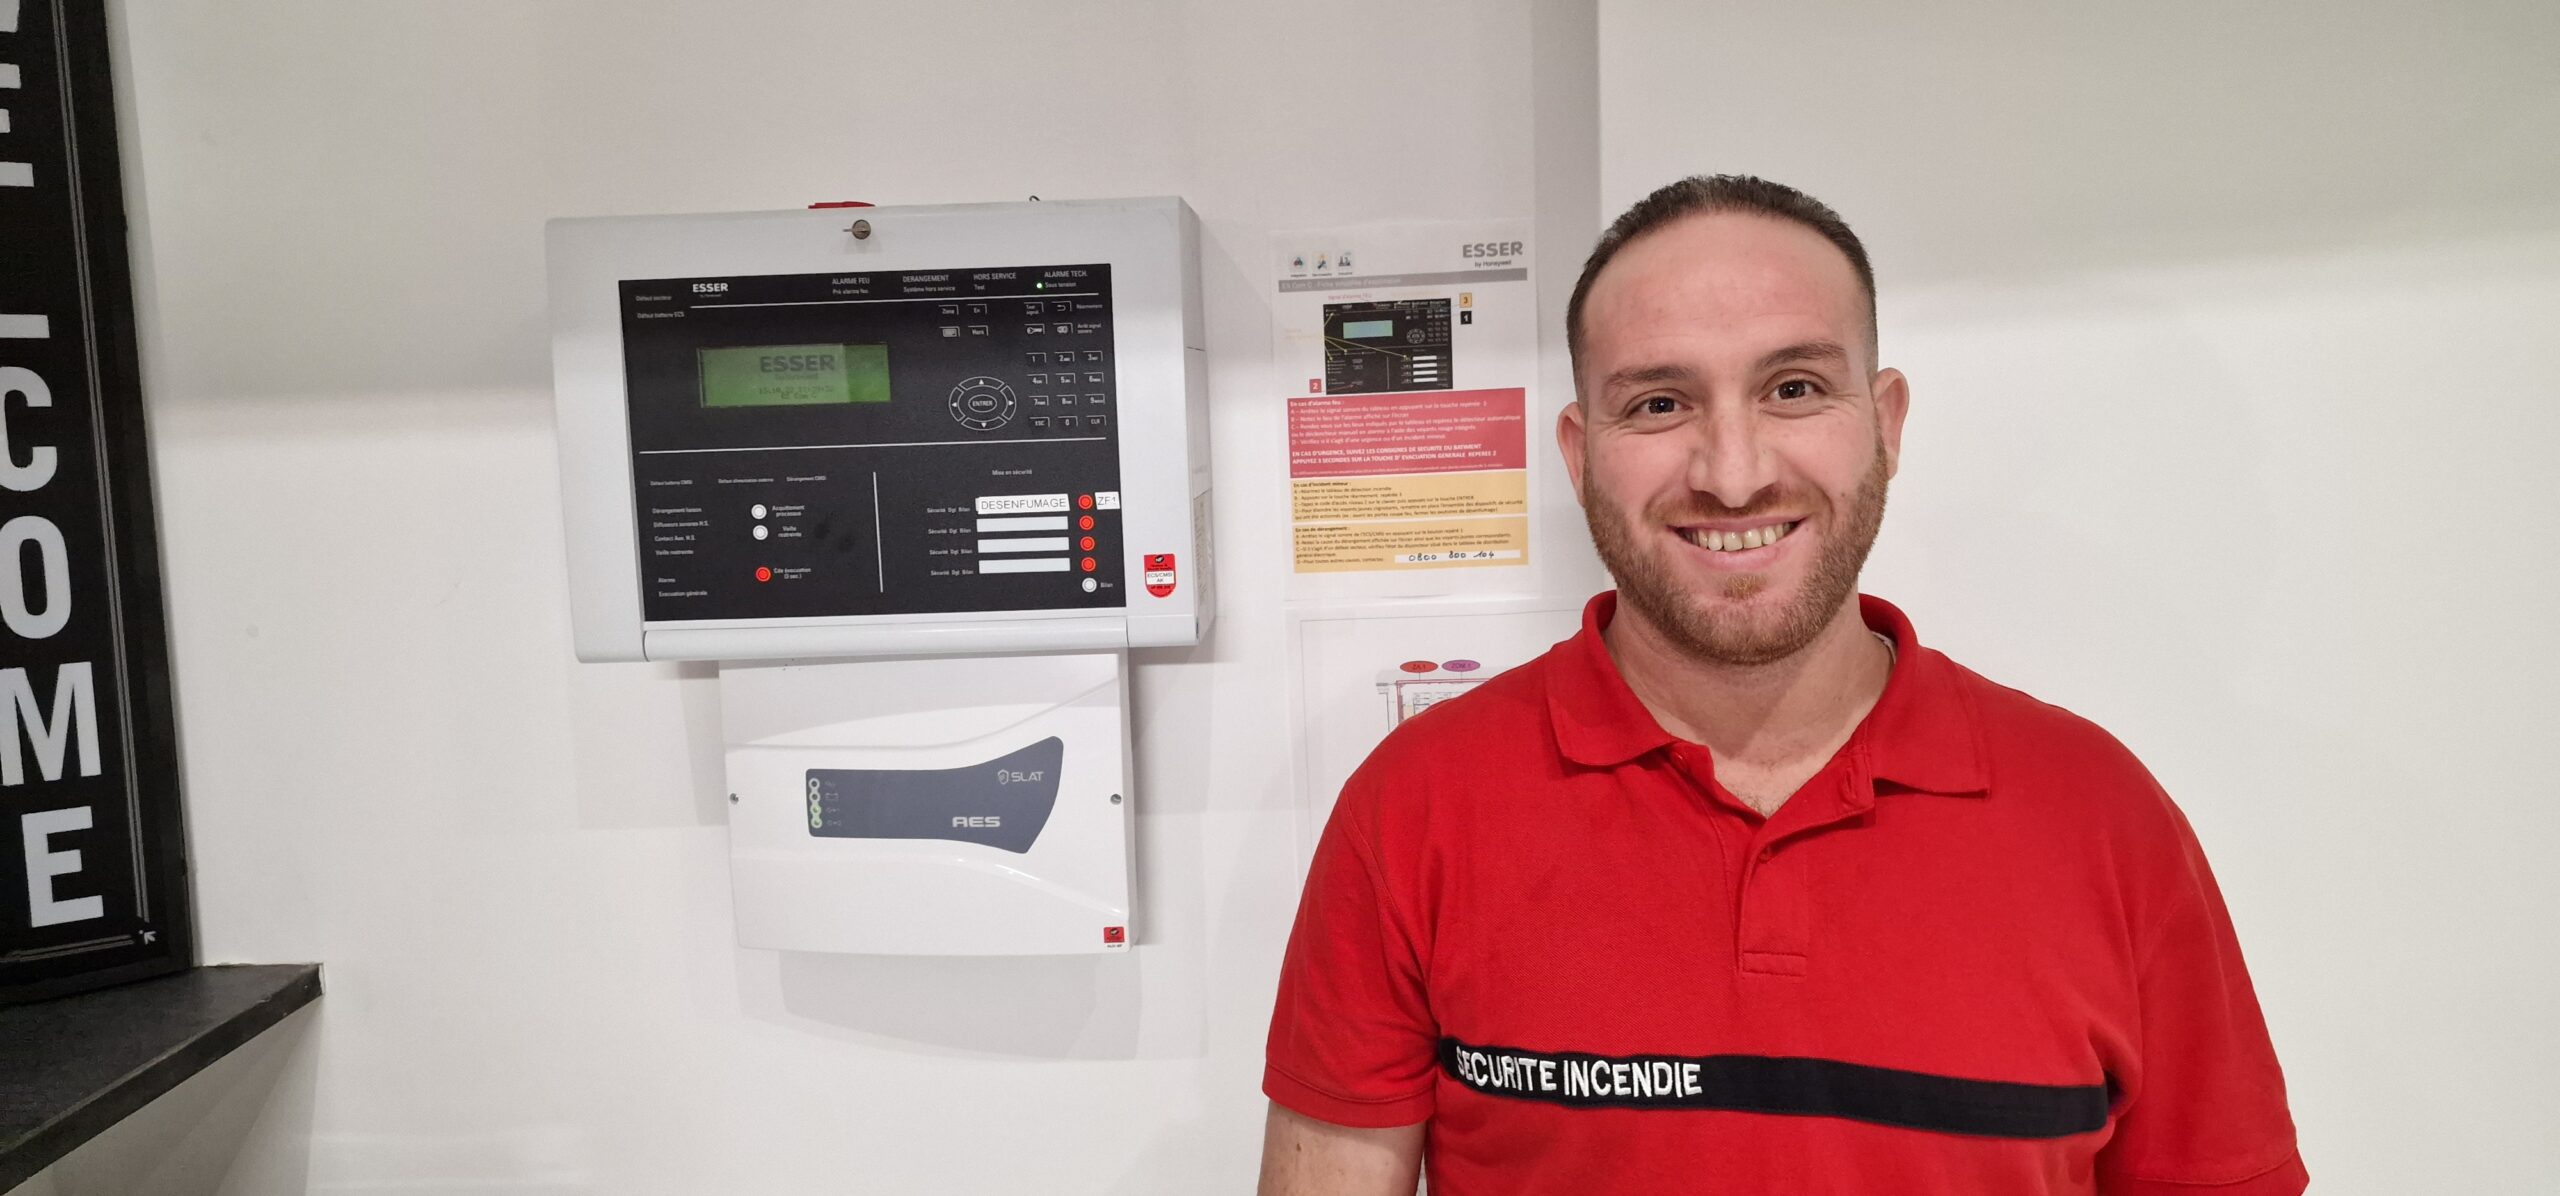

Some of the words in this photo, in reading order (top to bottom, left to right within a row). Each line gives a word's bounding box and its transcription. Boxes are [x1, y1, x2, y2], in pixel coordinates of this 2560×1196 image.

[1462, 241, 1523, 258] ESSER
[902, 274, 949, 282] DERANGEMENT
[992, 272, 1016, 280] SERVICE
[692, 283, 728, 292] ESSER
[1463, 296, 1469, 305] 3
[1464, 314, 1469, 322] 1
[760, 354, 835, 373] ESSER
[1312, 382, 1318, 390] 2
[0, 0, 103, 928] COME
[981, 498, 1067, 510] DESENFUMAGE
[1409, 553, 1437, 562] 0800
[1011, 771, 1044, 782] SLAT
[952, 816, 1001, 828] AES
[1456, 1045, 1557, 1091] SECURITE
[1563, 1060, 1702, 1098] INCENDIE
